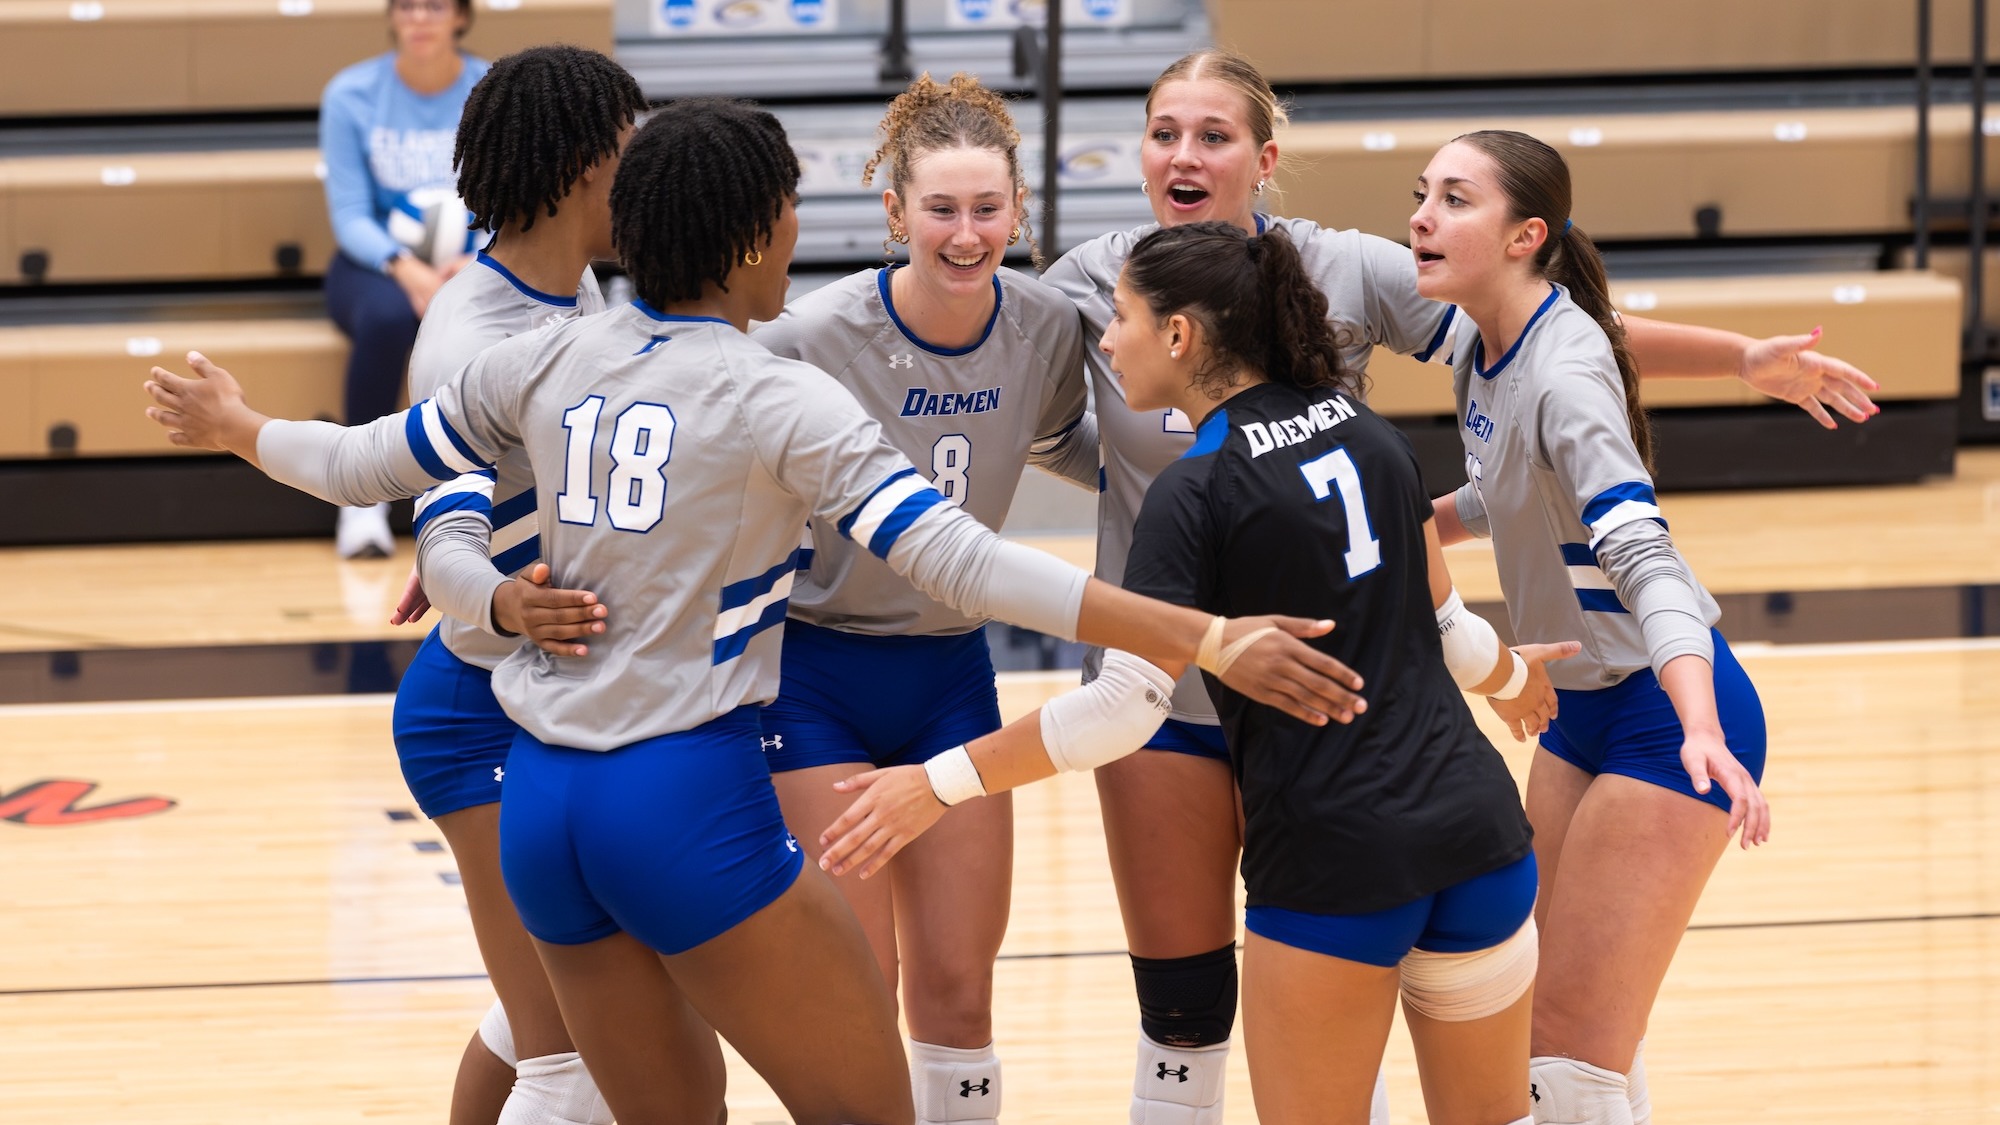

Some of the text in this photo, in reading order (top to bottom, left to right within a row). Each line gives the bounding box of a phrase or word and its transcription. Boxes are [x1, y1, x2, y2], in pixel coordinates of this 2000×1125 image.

[898, 386, 1003, 418] DAEMEN
[1240, 394, 1357, 459] DAEMEN
[556, 394, 677, 535] 18
[931, 433, 972, 508] 8
[1297, 443, 1385, 583] 7
